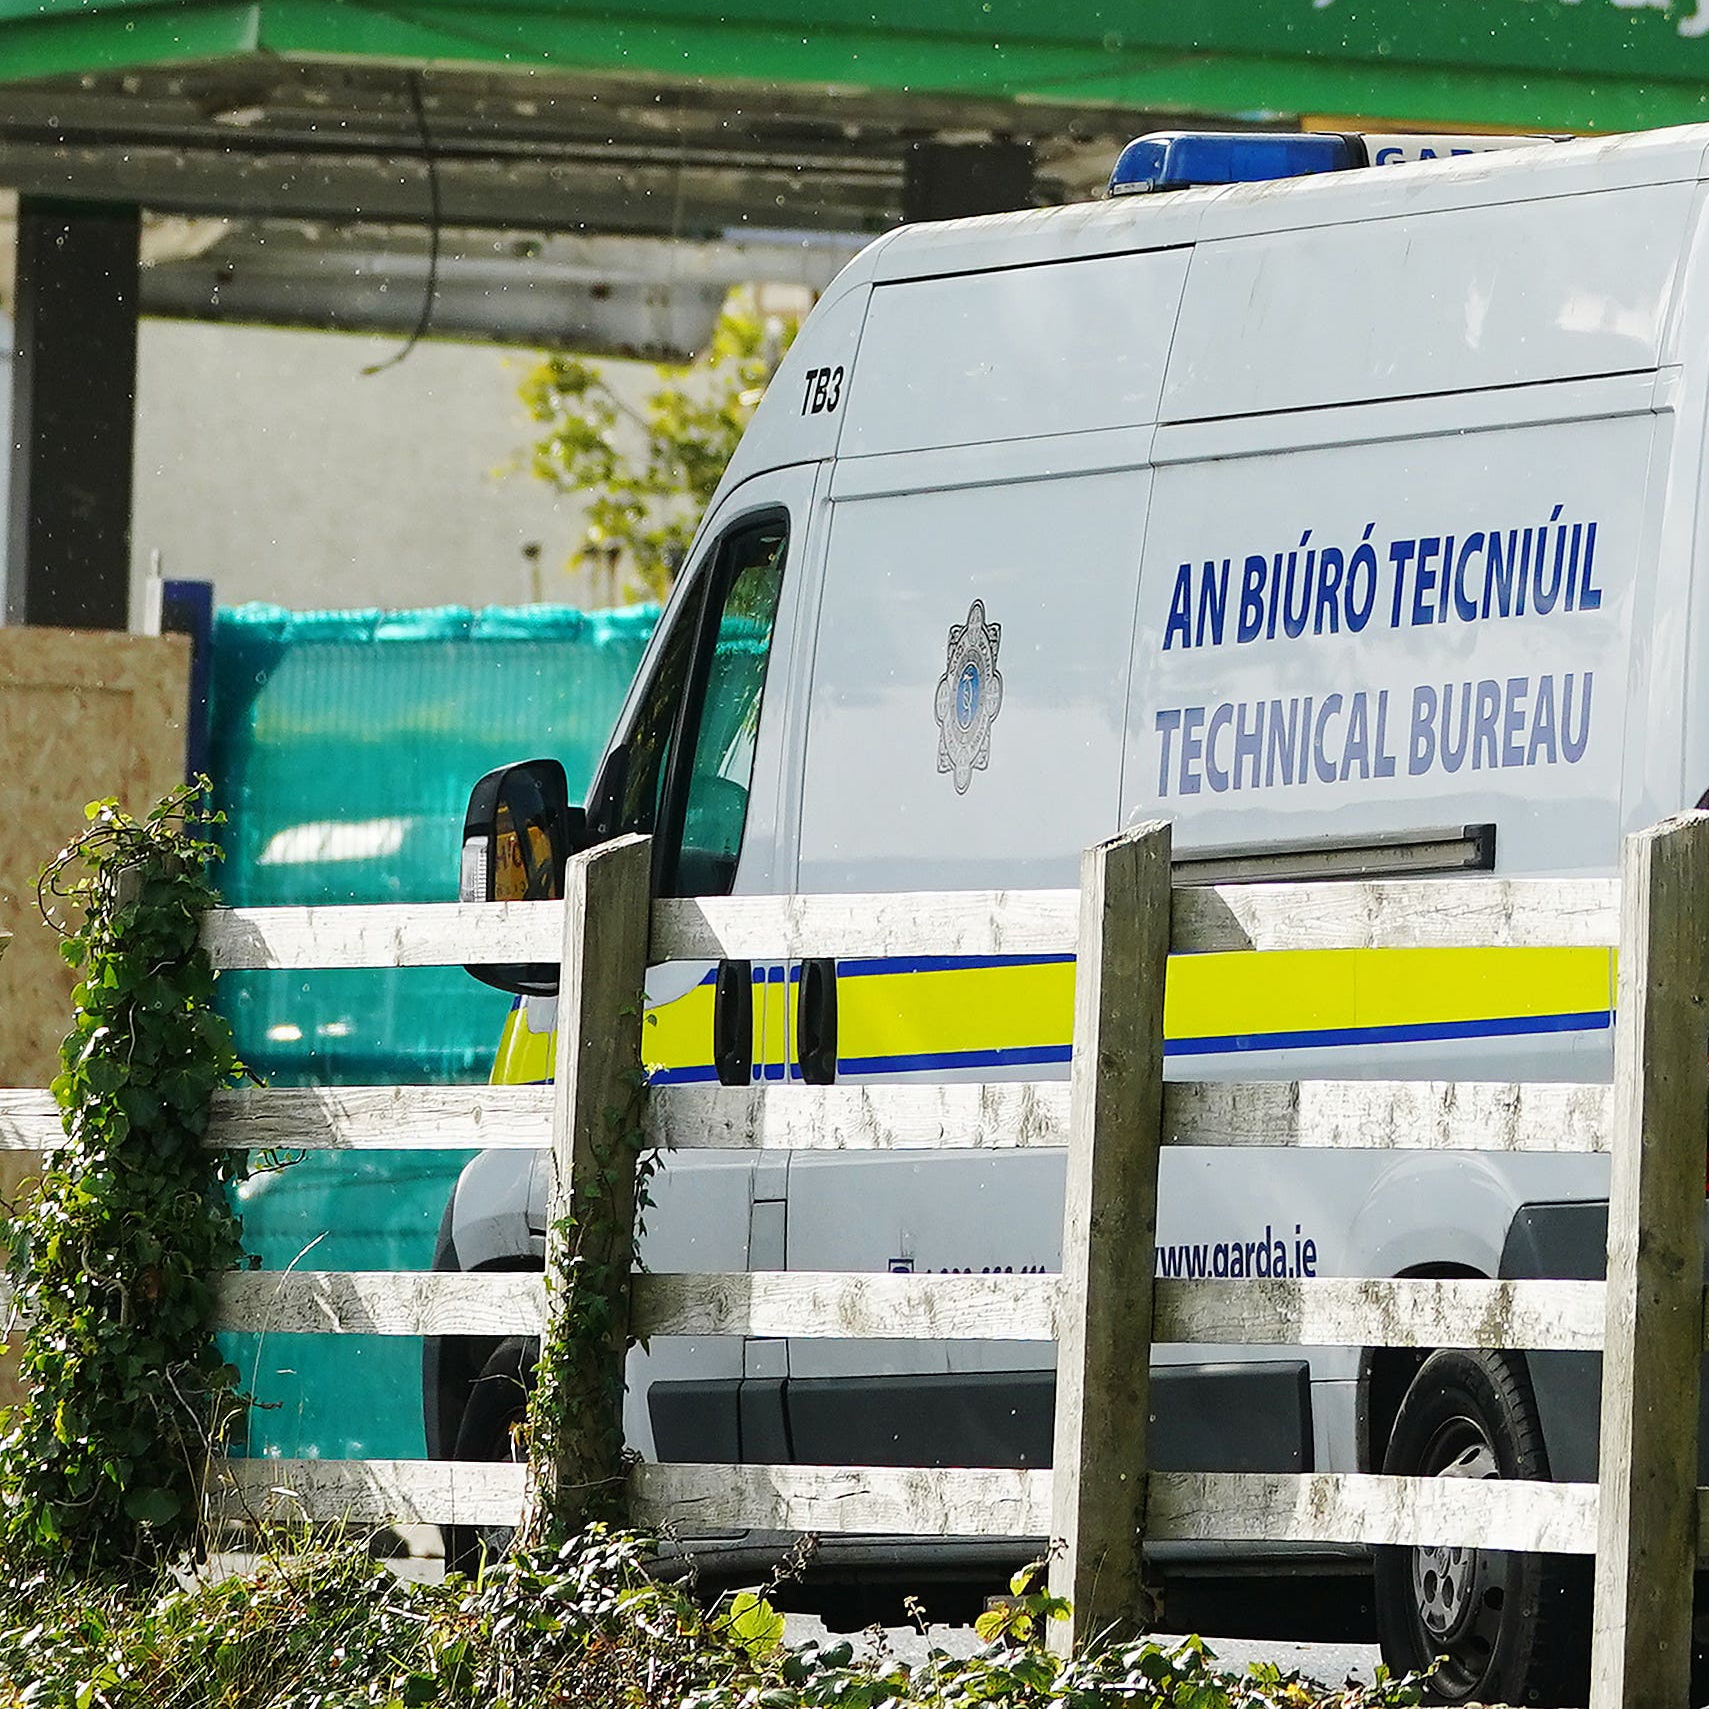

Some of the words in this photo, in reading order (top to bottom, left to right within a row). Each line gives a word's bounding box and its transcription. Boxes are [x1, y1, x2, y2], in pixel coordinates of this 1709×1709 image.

[801, 365, 845, 416] TB3
[1161, 558, 1231, 651] AN
[1235, 521, 1378, 644] BIÚRÓ
[1388, 503, 1603, 628] TEICNIÚIL
[1154, 690, 1396, 797] TECHNICAL
[1408, 670, 1595, 776] BUREAU
[1154, 1224, 1317, 1277] ww.garda.ie
